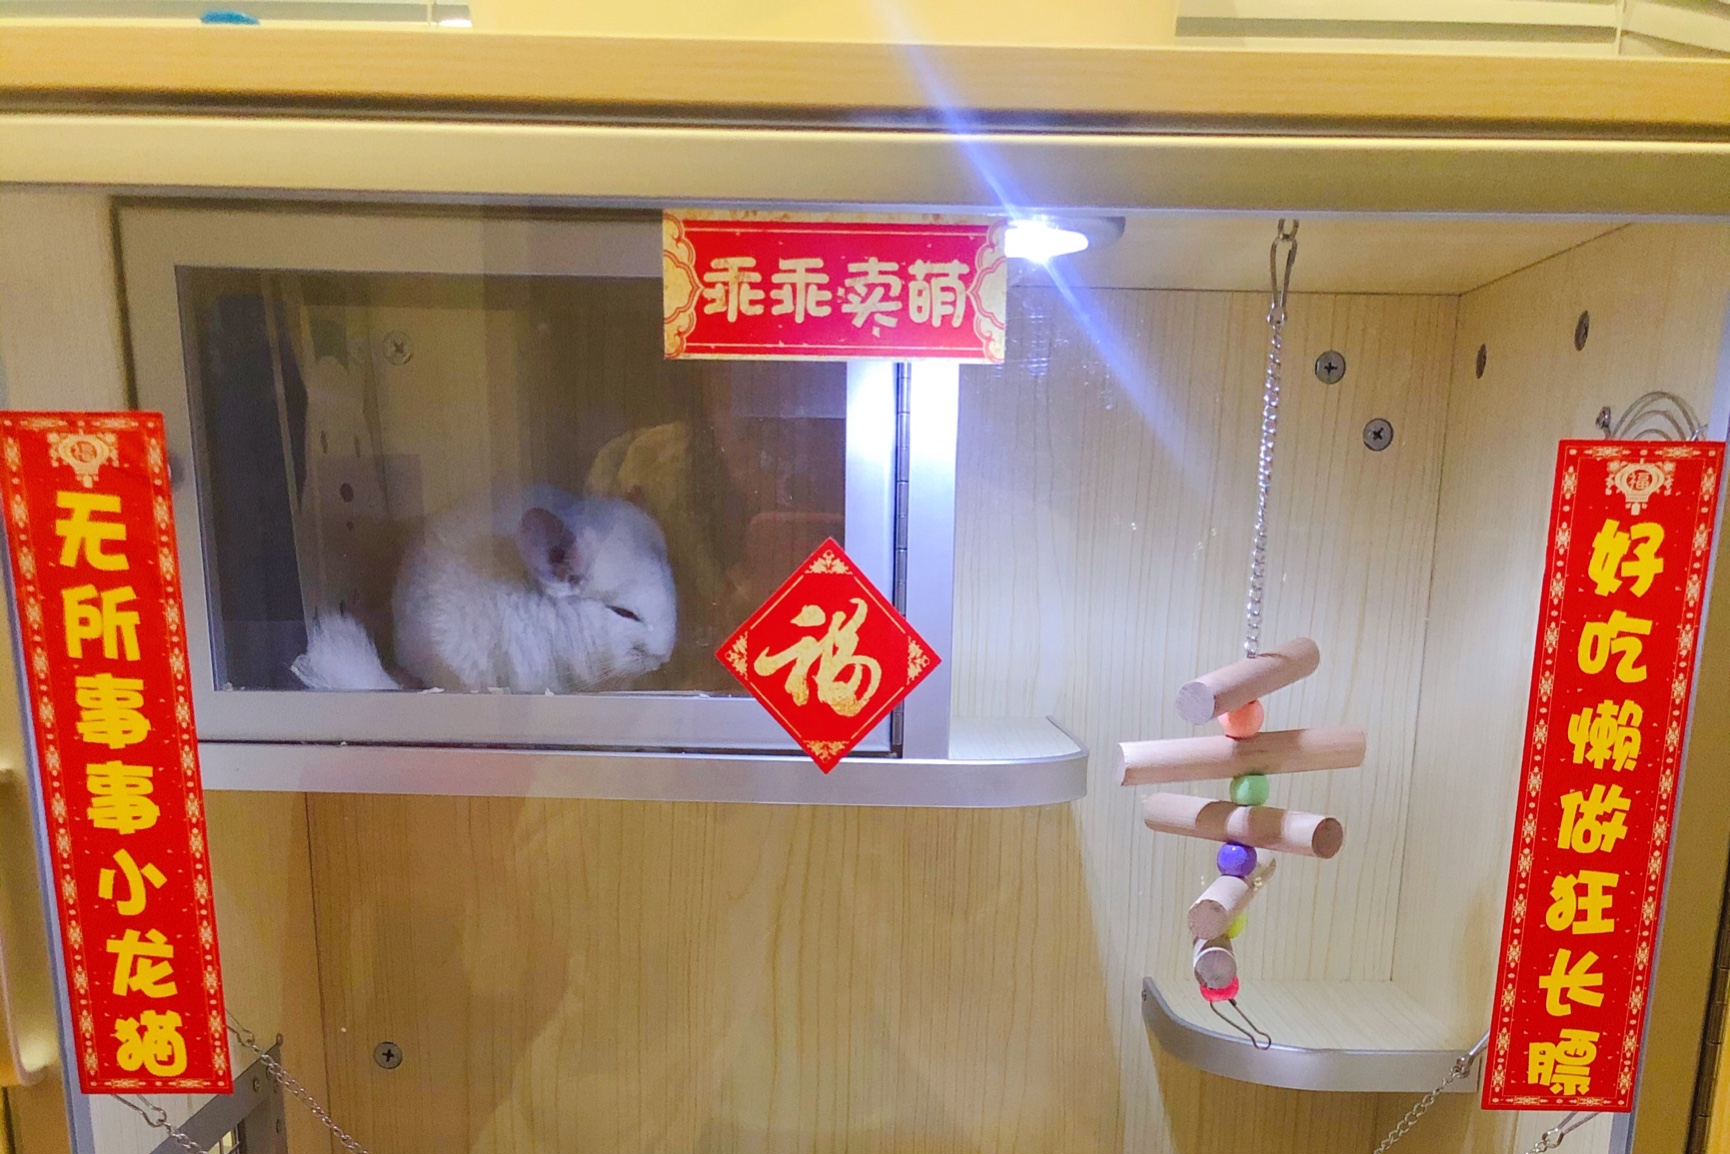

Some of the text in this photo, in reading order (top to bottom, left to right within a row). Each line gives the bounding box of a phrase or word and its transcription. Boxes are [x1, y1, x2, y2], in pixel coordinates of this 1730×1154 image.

[703, 256, 970, 337] 乖乖卖萌
[54, 490, 188, 1077] 无所事事小龙猫
[754, 597, 882, 717] 福
[1527, 518, 1665, 1095] 好吃懒做狂长膘
